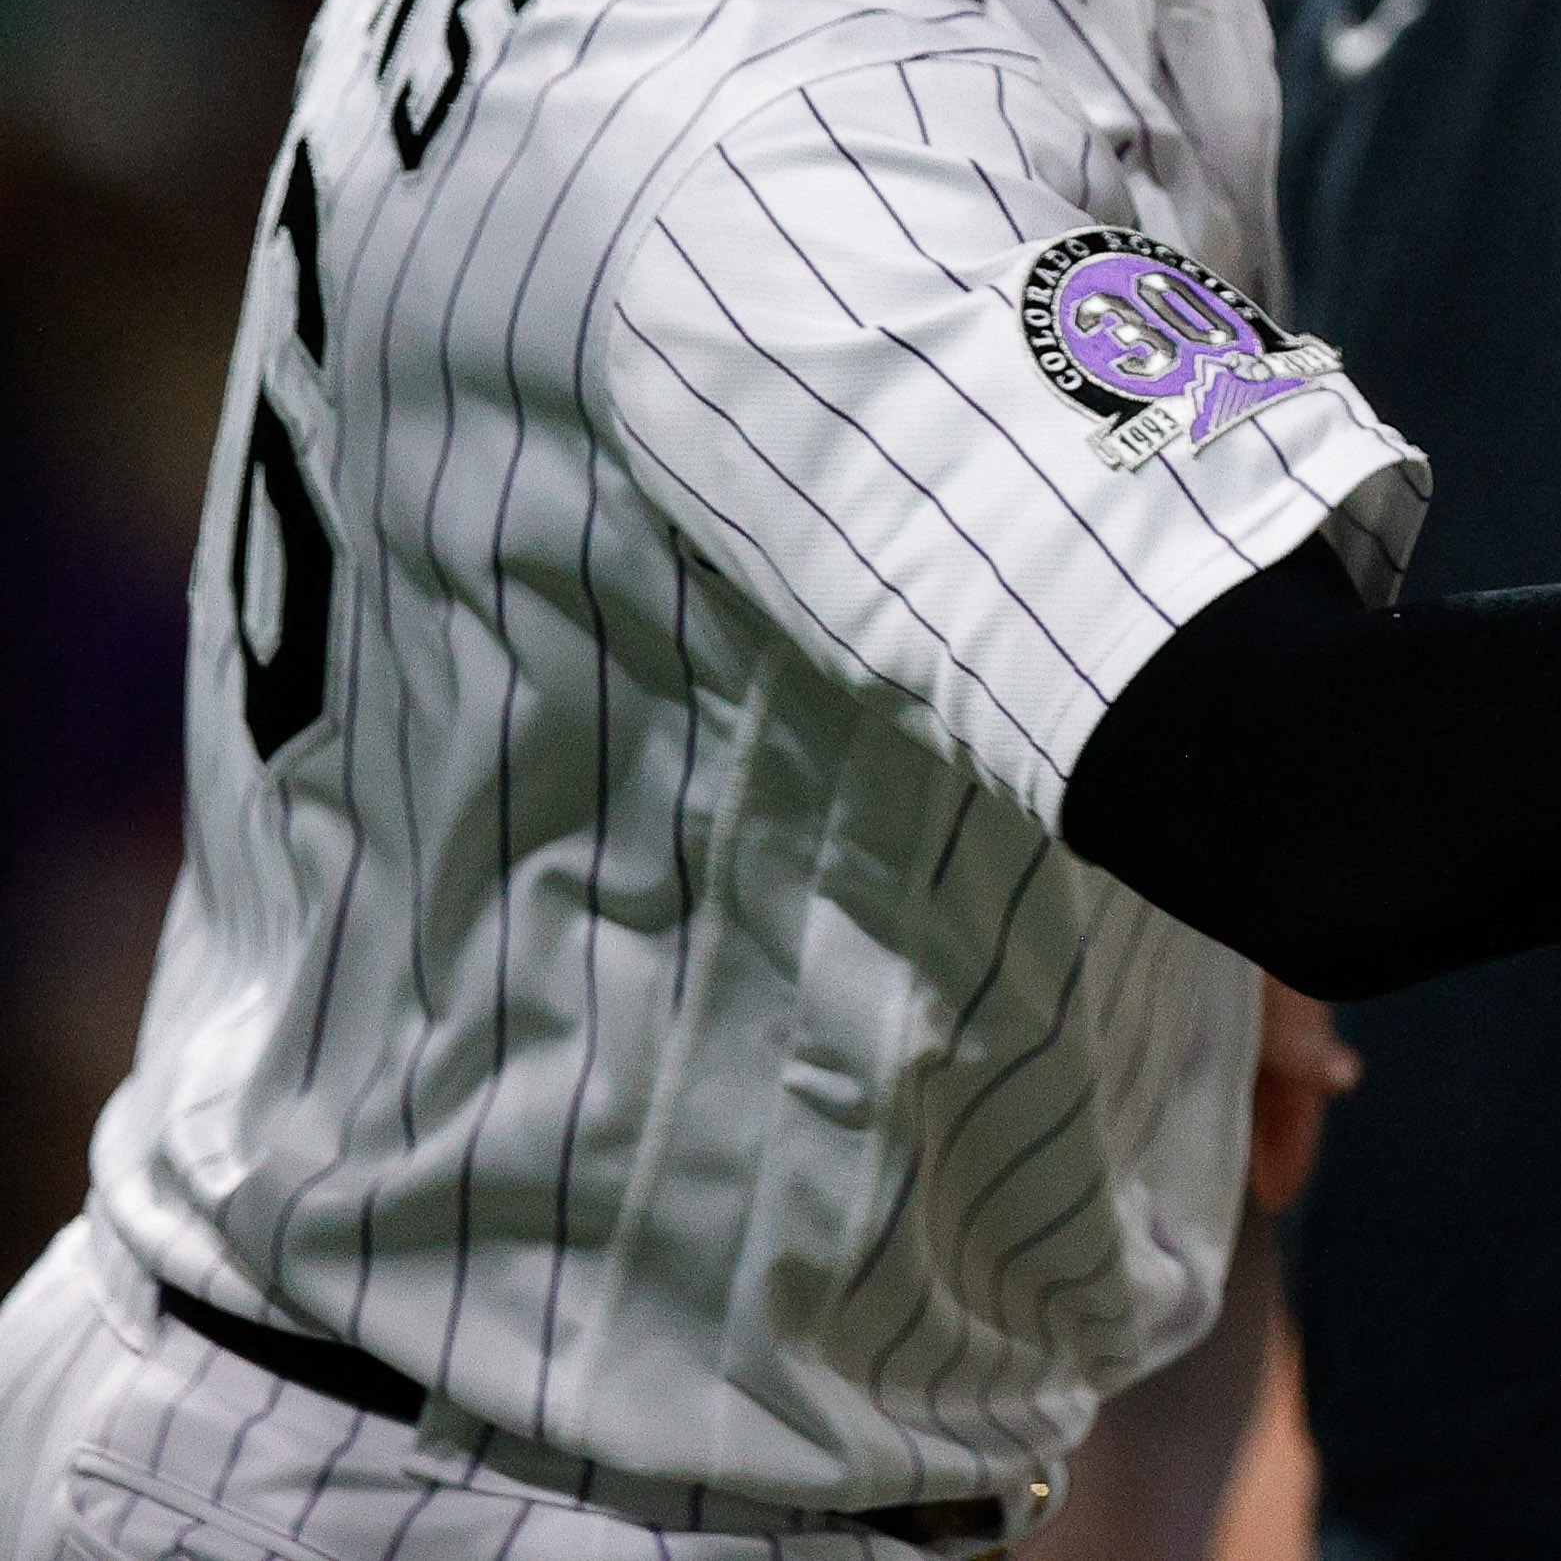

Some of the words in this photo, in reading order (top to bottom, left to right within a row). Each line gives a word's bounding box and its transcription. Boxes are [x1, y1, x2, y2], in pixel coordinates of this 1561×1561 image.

[1024, 236, 1092, 393] COLORADO
[1070, 271, 1241, 381] 30
[1117, 407, 1180, 457] 1993
